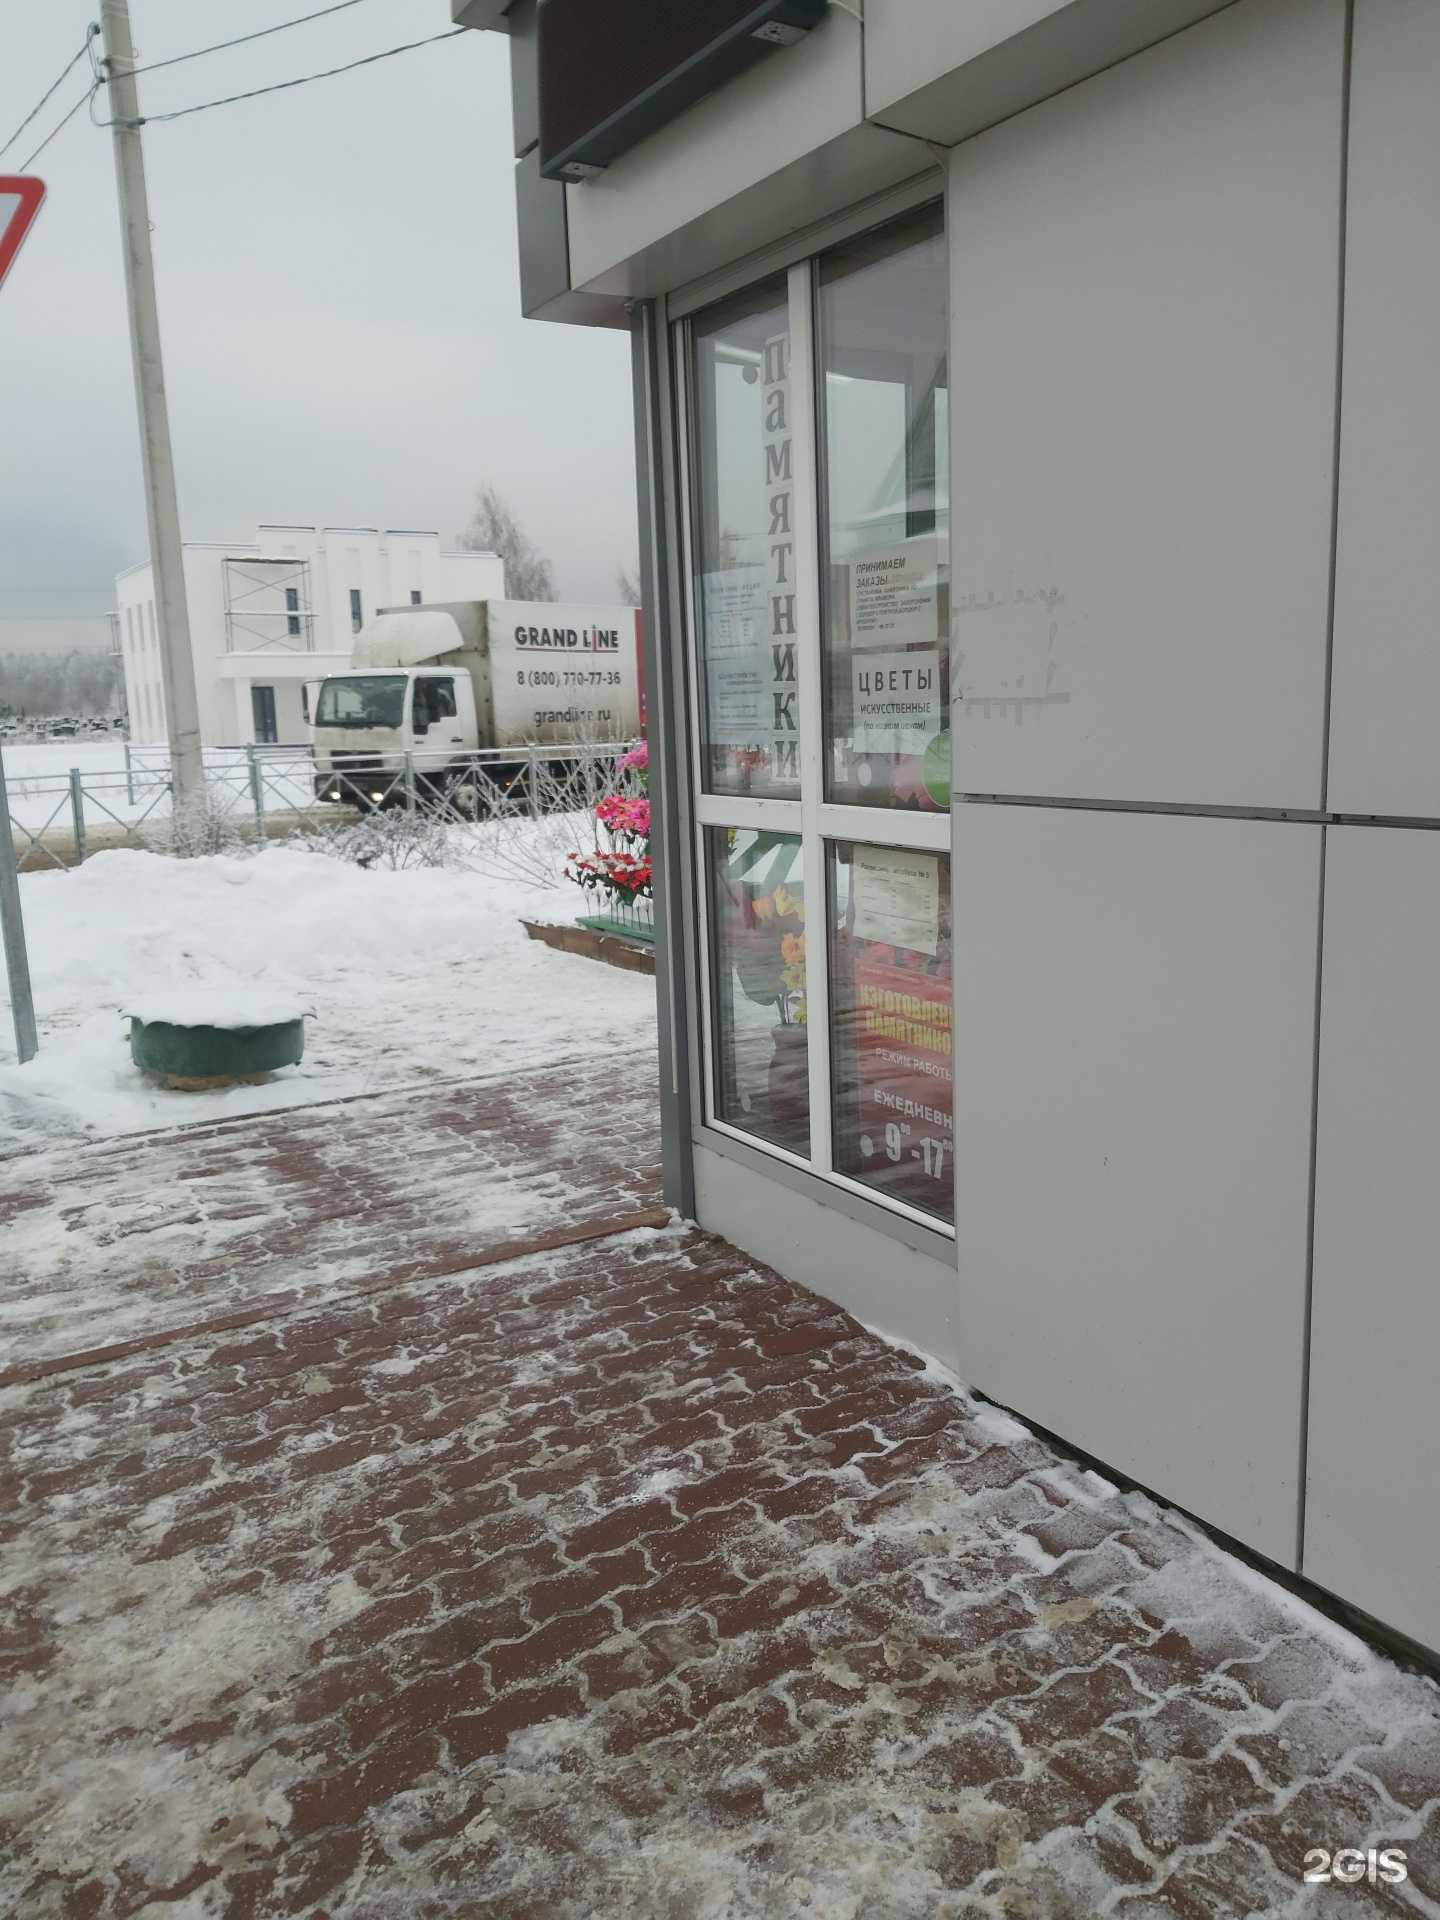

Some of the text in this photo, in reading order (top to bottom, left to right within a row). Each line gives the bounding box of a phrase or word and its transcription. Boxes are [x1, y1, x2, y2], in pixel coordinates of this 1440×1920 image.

[856, 557, 906, 574] ПРИНИМАЕМ
[856, 575, 888, 588] ЗАКАЗЫ
[514, 624, 619, 651] GRAND LINE
[517, 670, 525, 685] 8
[528, 670, 560, 688] (800)
[858, 668, 932, 697] ЦВЕТЫ
[860, 702, 931, 714] ИСКУССТВЕННЫЕ
